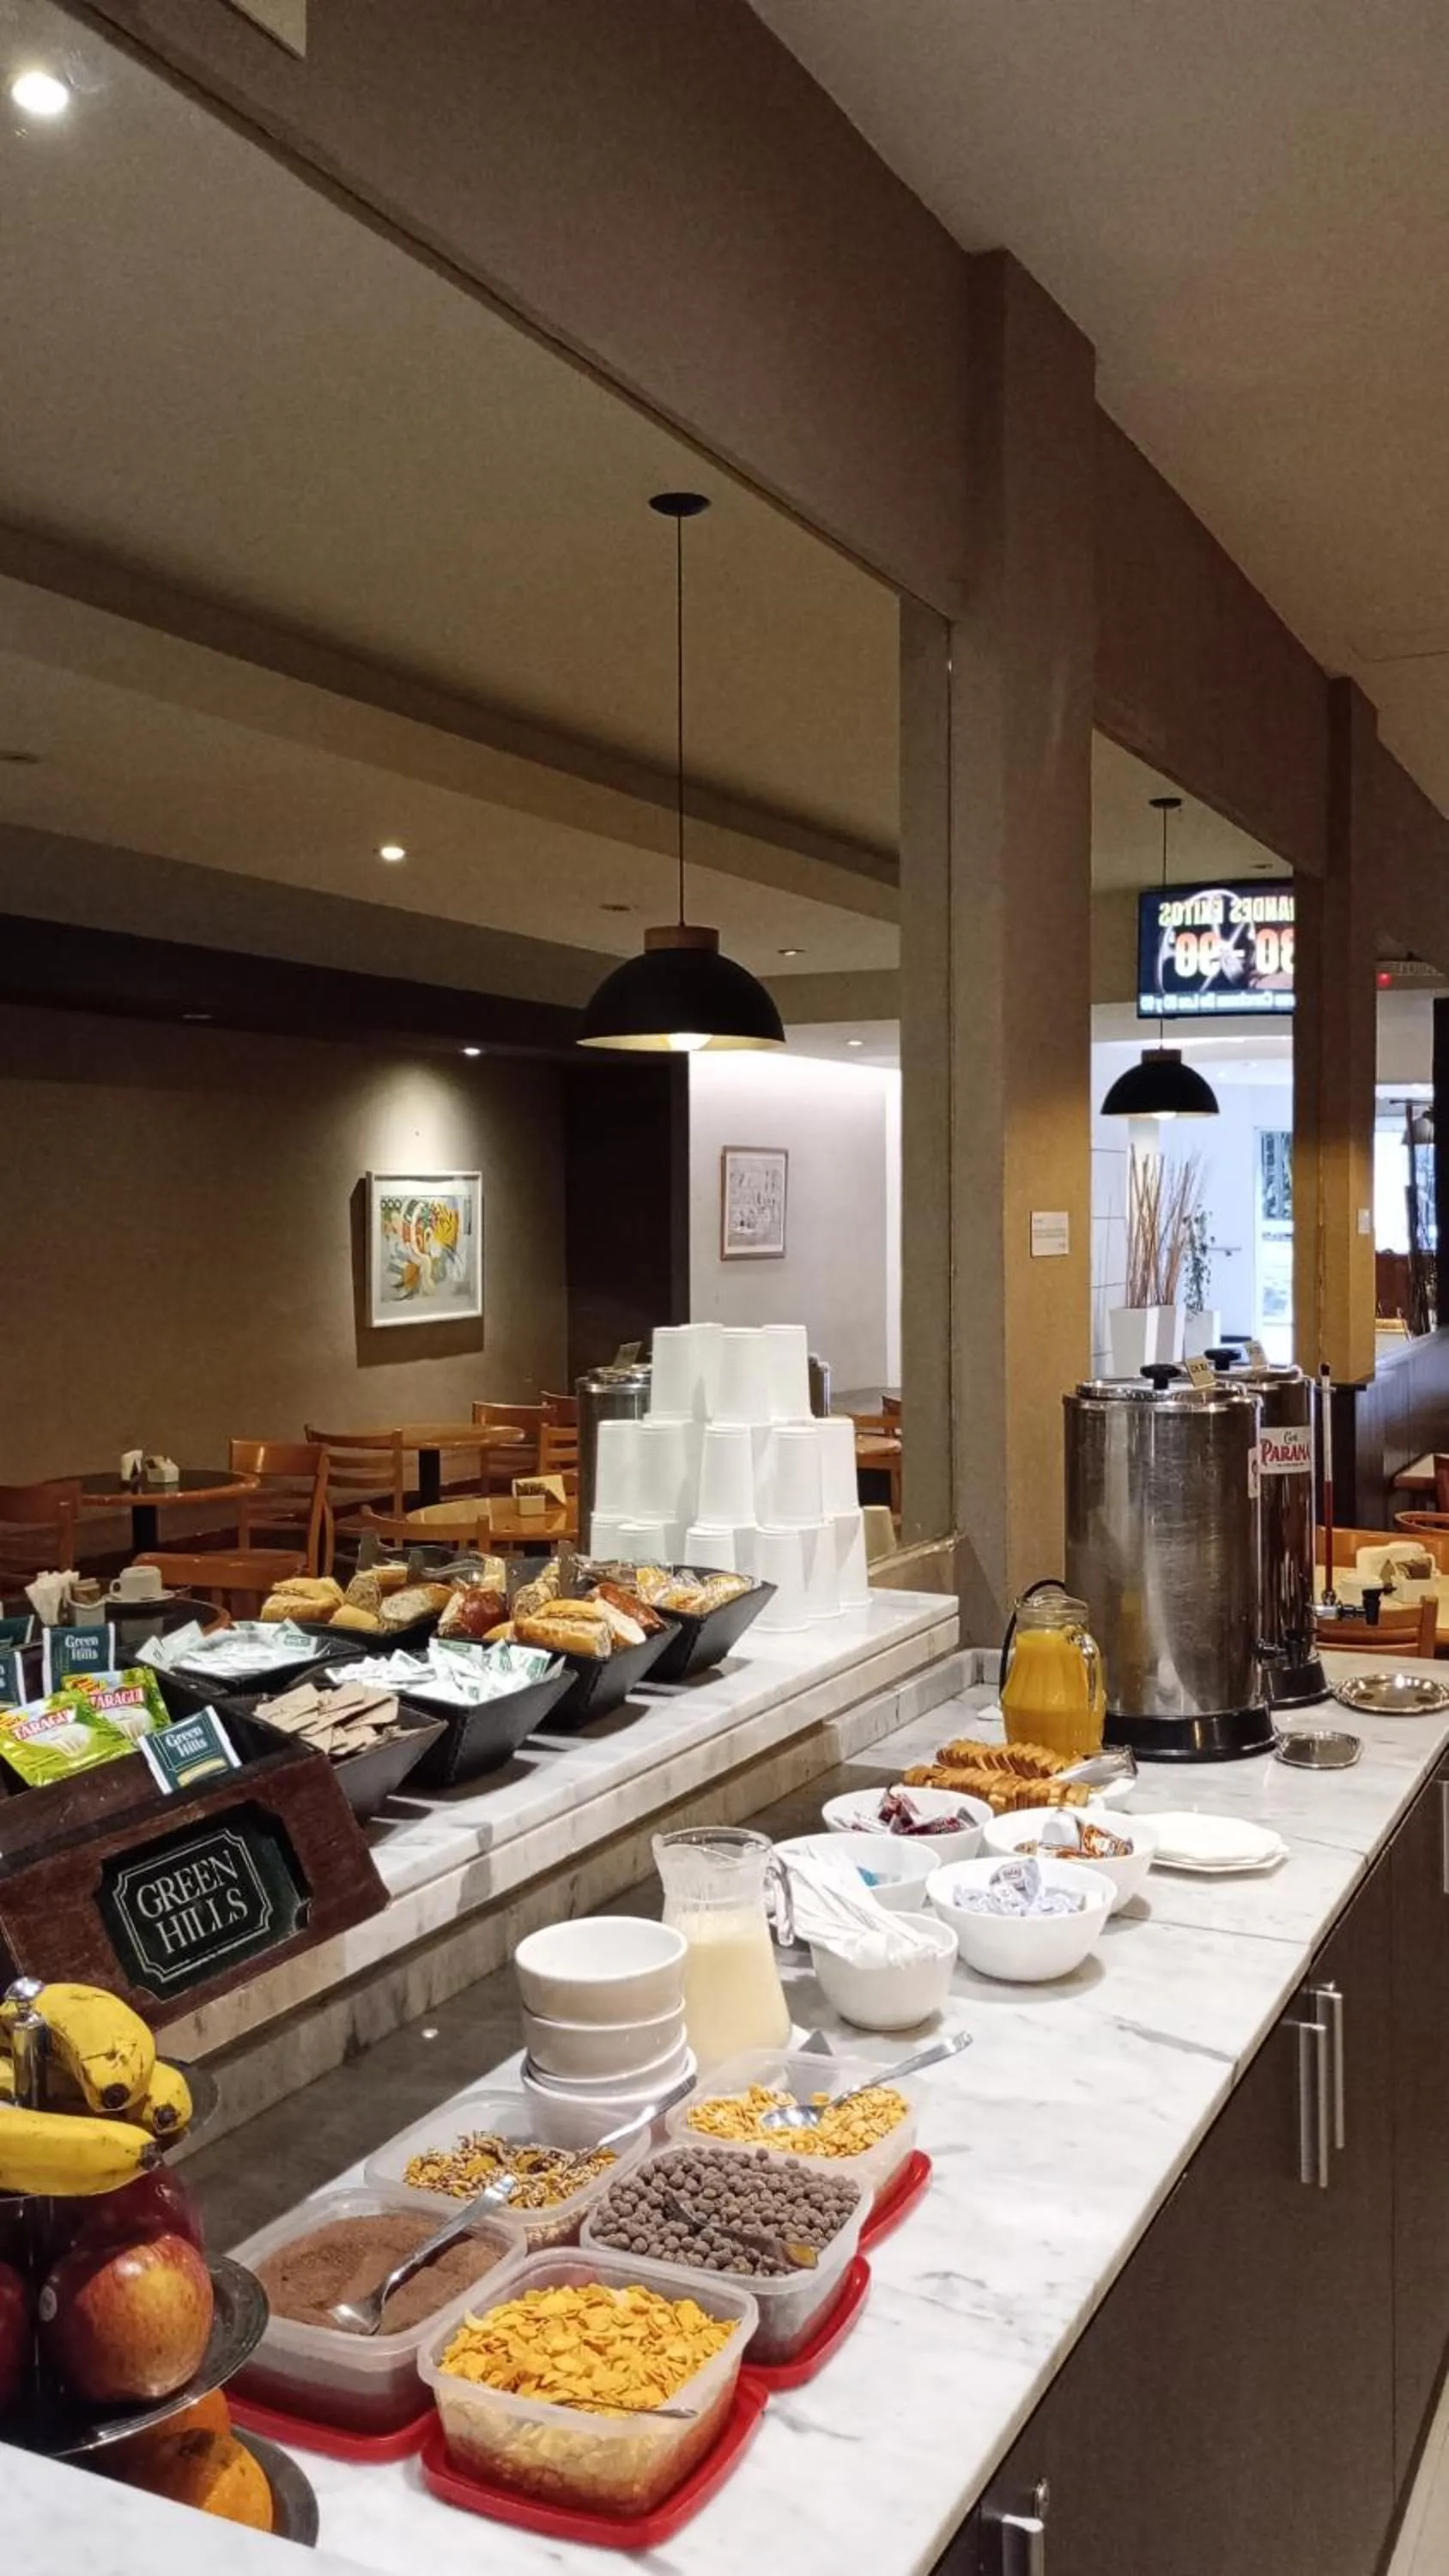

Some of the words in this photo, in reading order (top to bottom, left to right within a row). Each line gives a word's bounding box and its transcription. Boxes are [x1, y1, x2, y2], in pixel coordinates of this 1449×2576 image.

[64, 1634, 99, 1648] Green
[71, 1648, 99, 1661] Hills
[165, 1726, 204, 1747] Green
[176, 1738, 208, 1758] Hills
[136, 1849, 239, 1919] GREEN
[155, 1888, 248, 1954] HILLS
